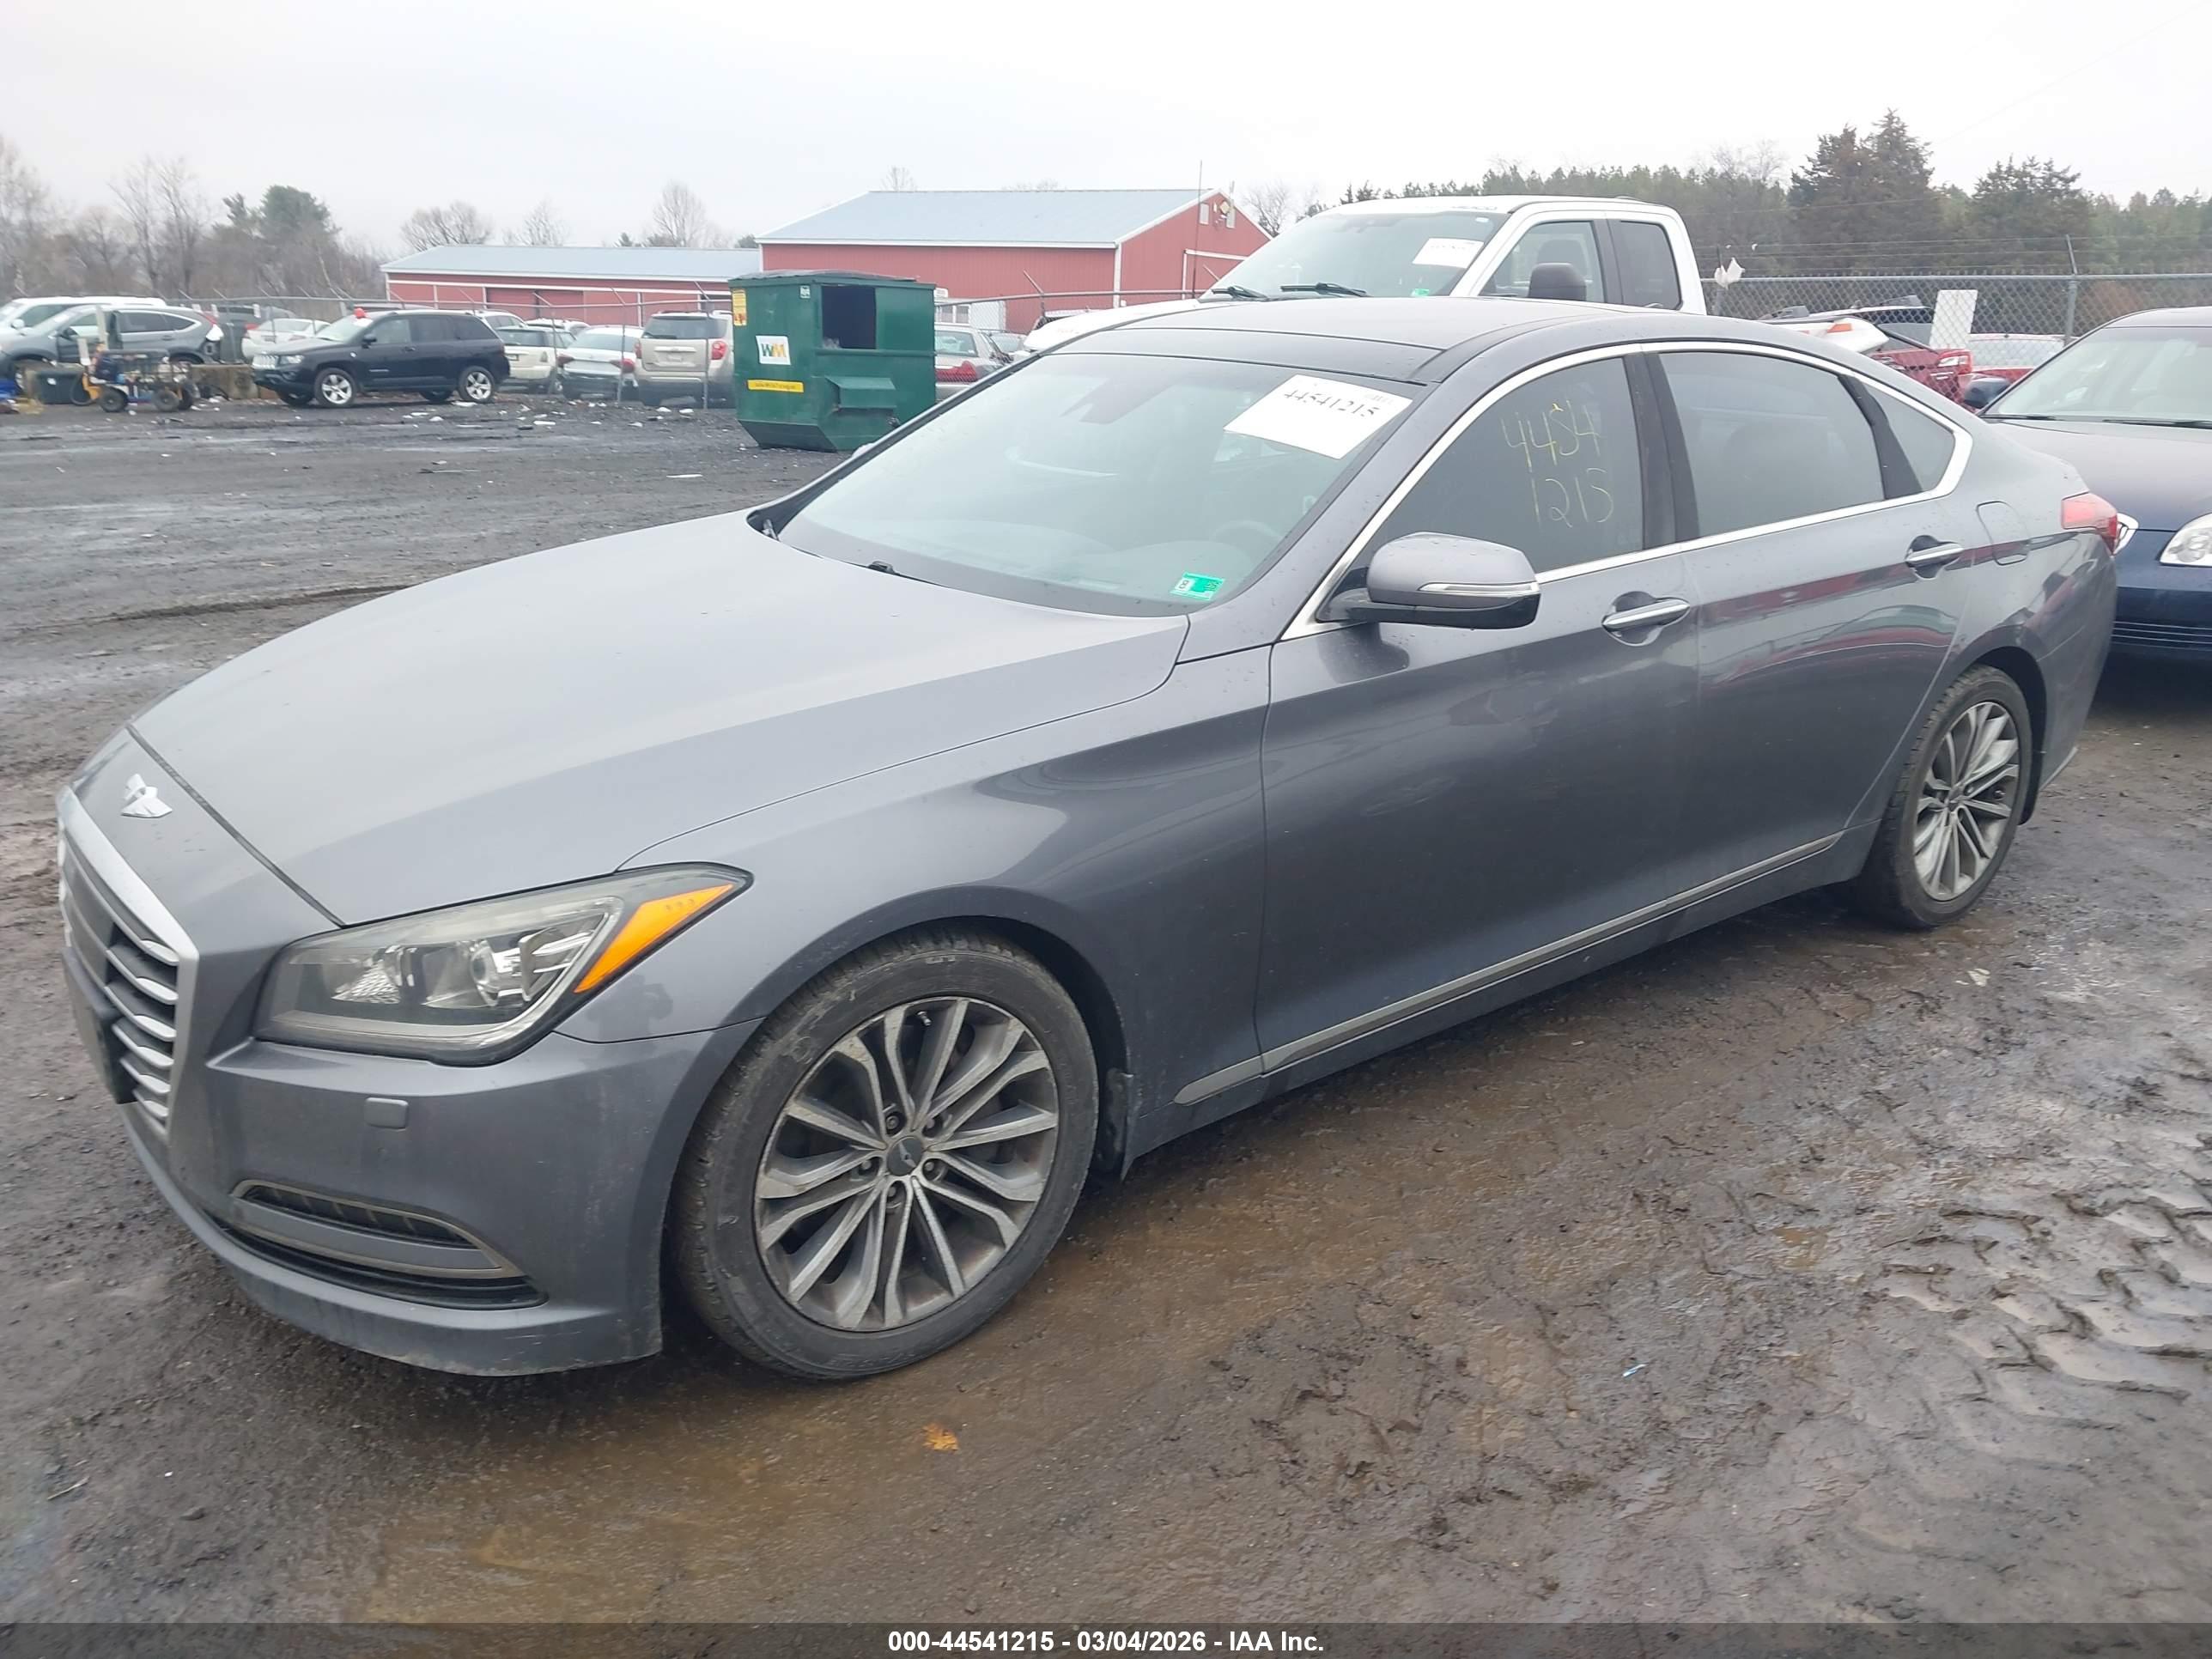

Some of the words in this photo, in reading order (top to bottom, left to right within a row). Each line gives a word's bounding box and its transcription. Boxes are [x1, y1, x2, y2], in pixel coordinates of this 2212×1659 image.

[762, 343, 787, 357] WM
[1284, 389, 1381, 417] 44541215
[1500, 399, 1601, 473] 4454
[1530, 467, 1614, 528] 1215
